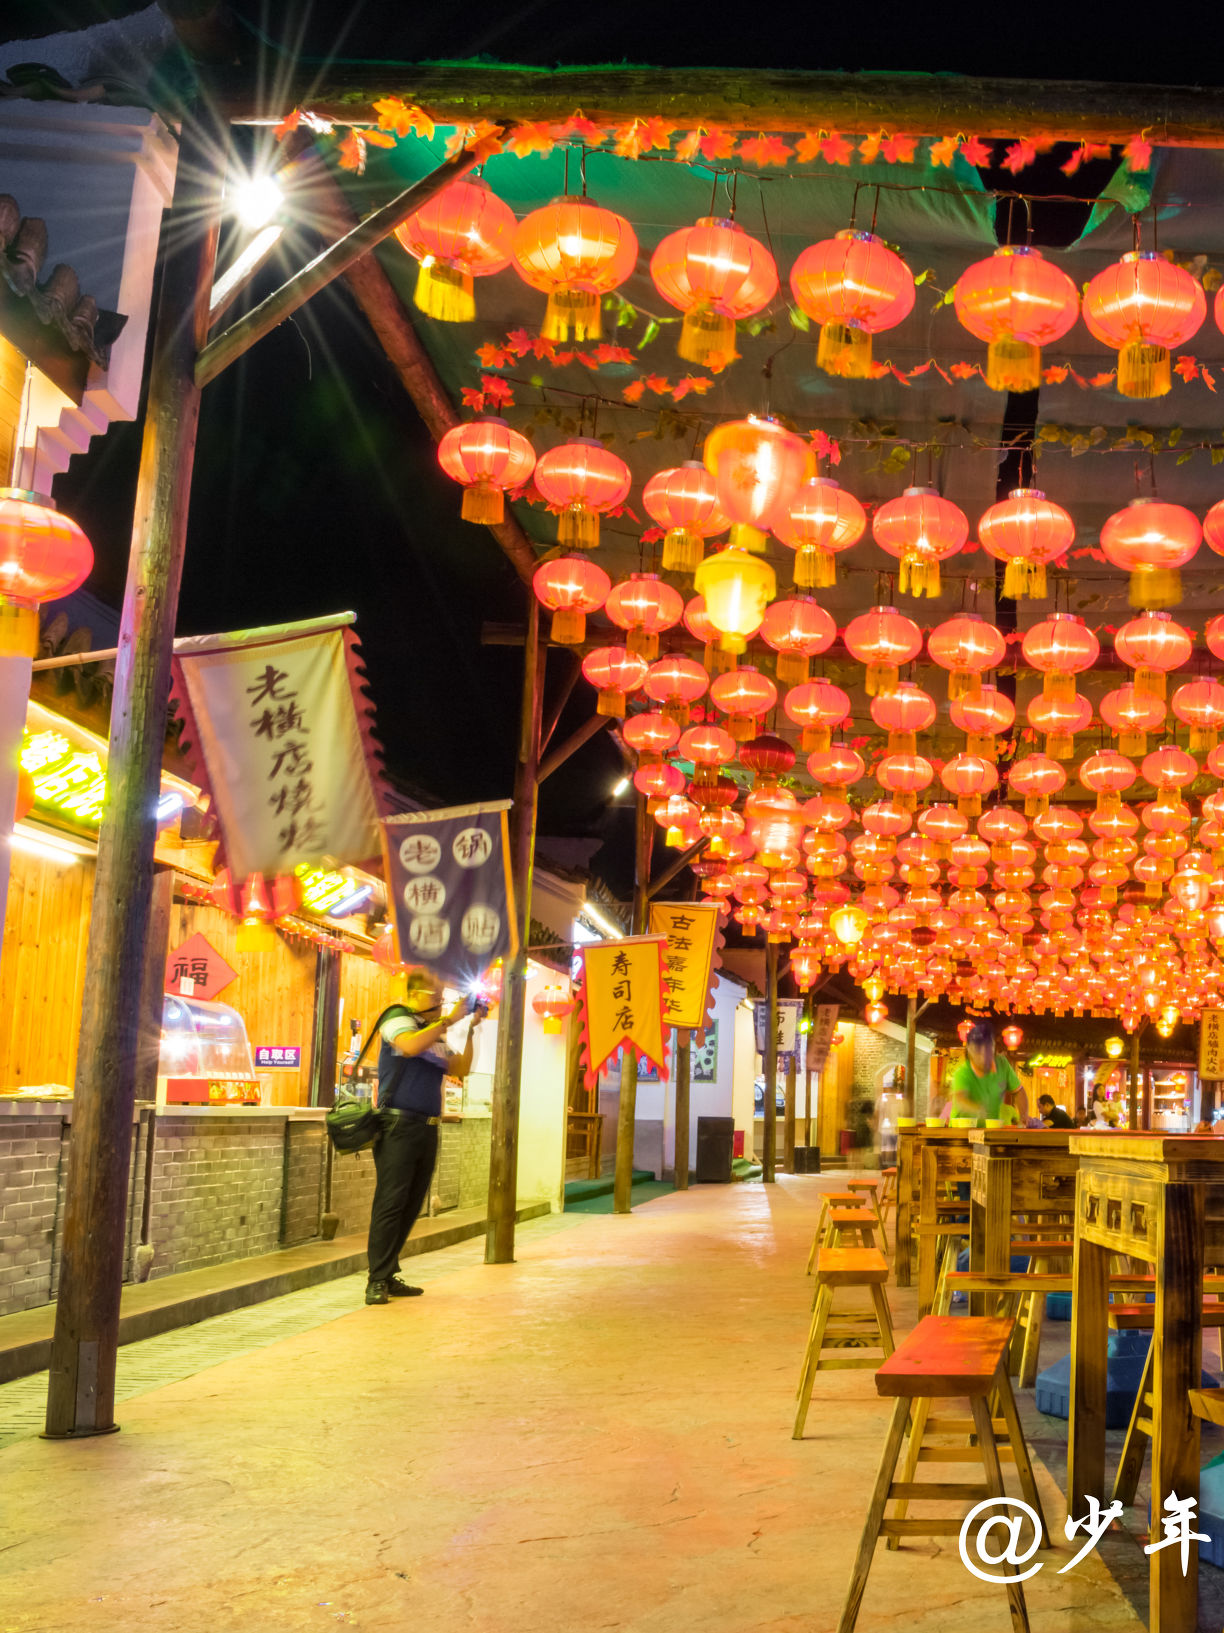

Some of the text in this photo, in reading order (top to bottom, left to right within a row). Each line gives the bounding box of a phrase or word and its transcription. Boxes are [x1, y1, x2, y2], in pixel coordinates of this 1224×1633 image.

[171, 957, 209, 987] 福
[611, 950, 635, 1032] 寿司店
[259, 1048, 297, 1060] 自取区
